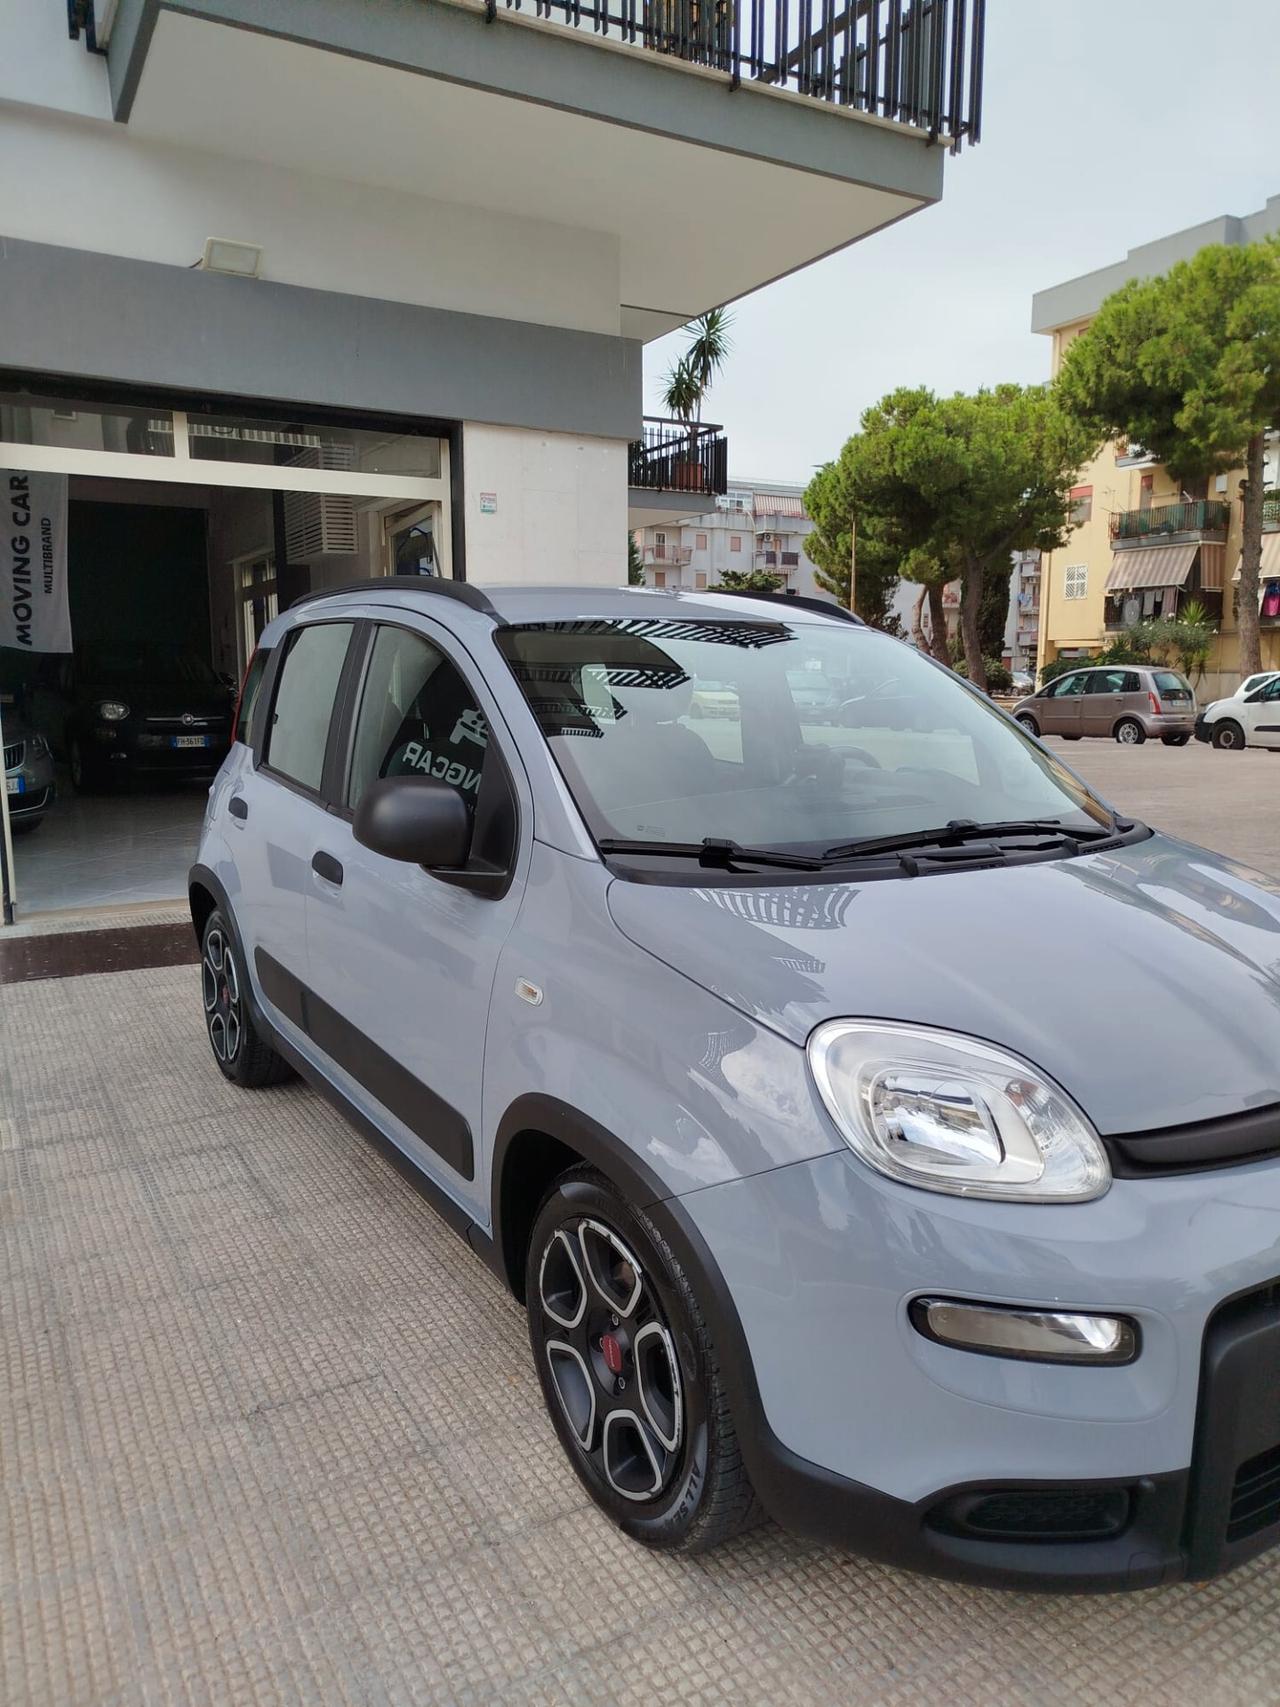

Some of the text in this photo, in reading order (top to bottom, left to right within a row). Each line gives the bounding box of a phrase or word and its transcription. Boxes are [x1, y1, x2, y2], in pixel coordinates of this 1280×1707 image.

[9, 475, 33, 646] MOVING CAR
[41, 517, 54, 594] MULTIBRAND
